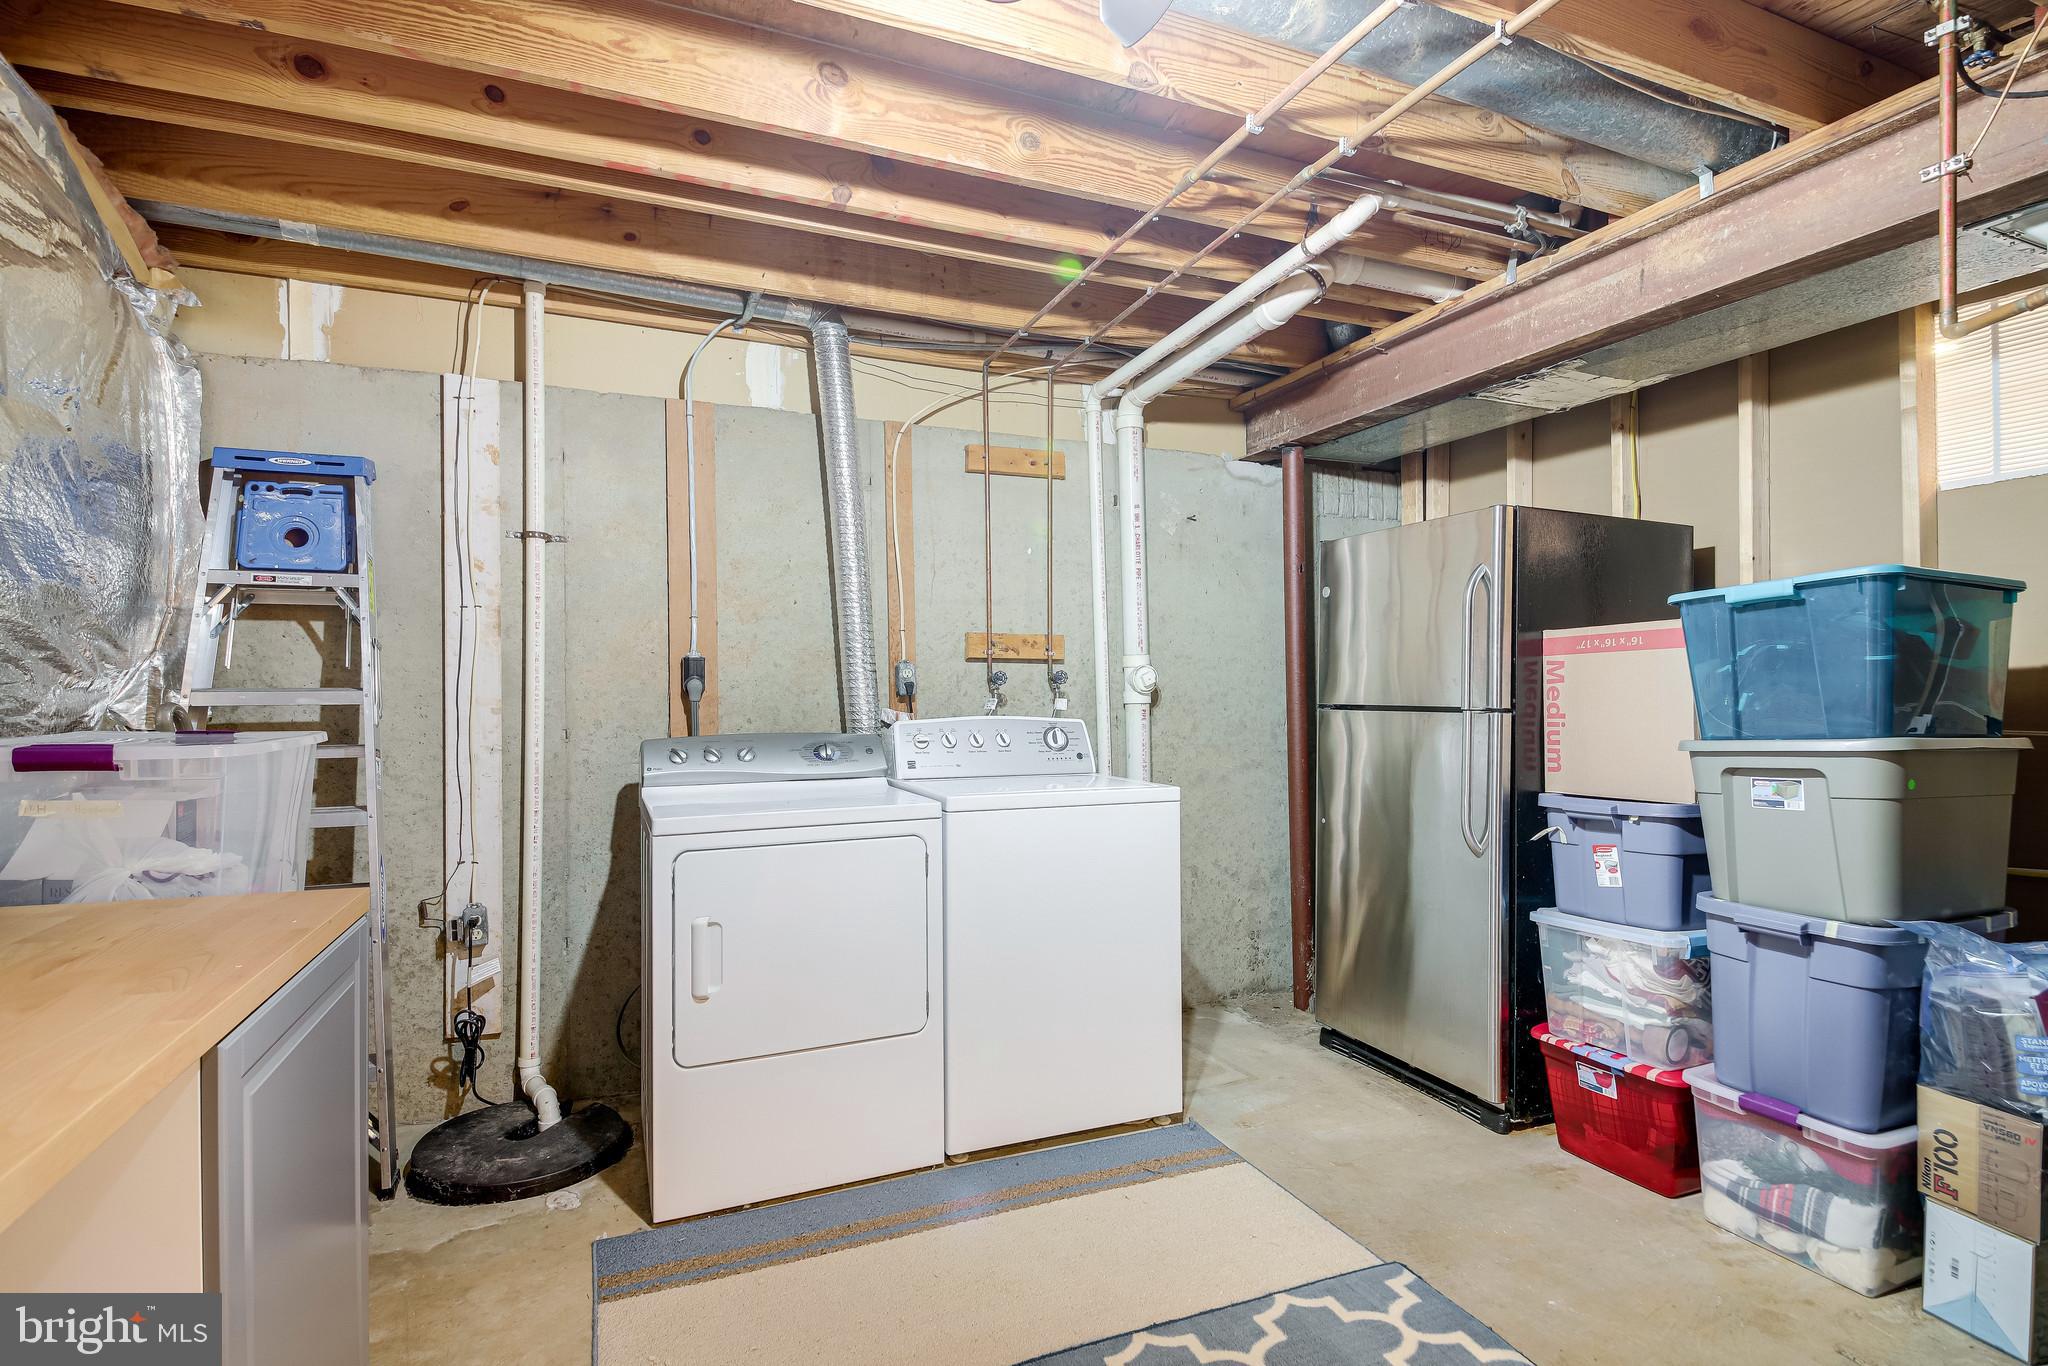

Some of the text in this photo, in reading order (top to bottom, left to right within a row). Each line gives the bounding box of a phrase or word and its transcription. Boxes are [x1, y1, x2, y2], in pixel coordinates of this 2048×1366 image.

[1546, 660, 1566, 772] Medium
[1921, 1157, 1932, 1190] Nikon
[1933, 1128, 1959, 1201] F100
